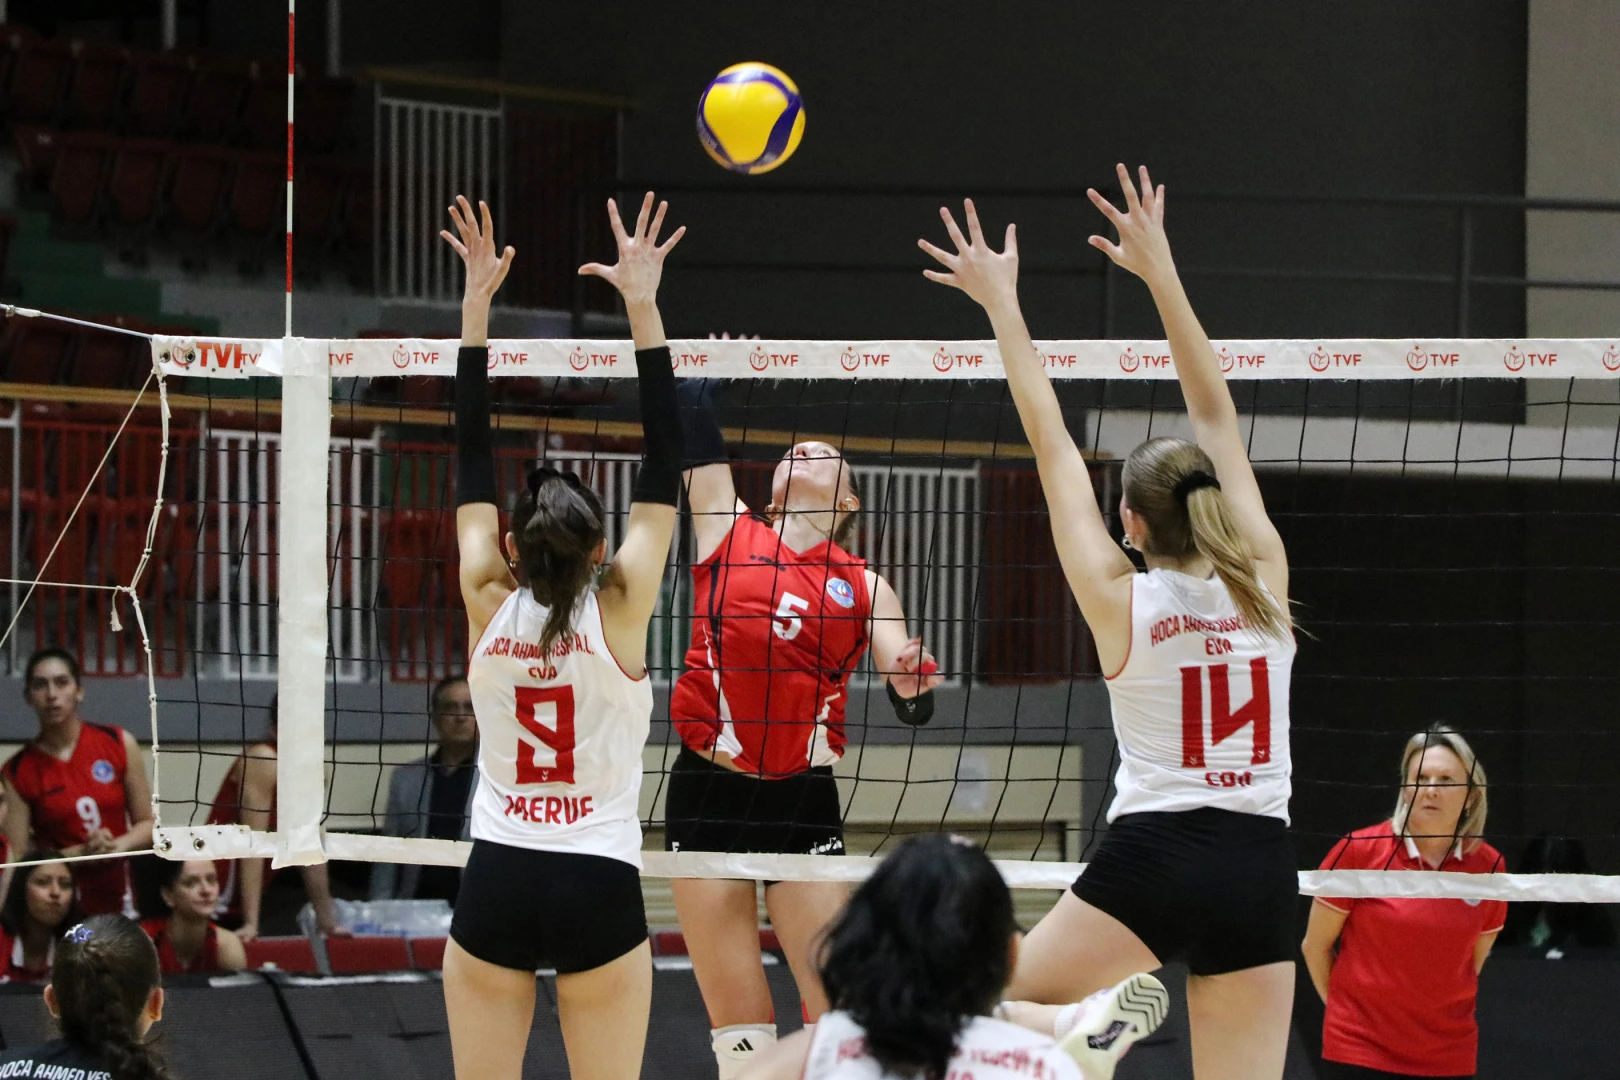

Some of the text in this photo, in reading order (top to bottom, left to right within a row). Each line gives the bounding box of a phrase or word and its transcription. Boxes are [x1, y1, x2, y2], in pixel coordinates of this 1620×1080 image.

[241, 353, 261, 365] TV
[329, 353, 353, 365] TVF
[413, 351, 439, 363] TVF
[501, 353, 528, 365] TVF
[590, 353, 617, 366] TVF
[681, 354, 708, 366] TVF
[771, 354, 798, 366] TVF
[863, 354, 889, 366] TVF
[956, 355, 982, 366] TVF
[1048, 355, 1076, 366] TVF
[1142, 355, 1170, 367] TVF
[1237, 355, 1265, 367] TVF
[1333, 354, 1361, 366] TVF
[1430, 353, 1459, 366] TVF
[1528, 353, 1557, 366] TVF
[773, 592, 809, 640] 5
[1150, 615, 1180, 647] HOCA
[1205, 638, 1234, 656] EVA
[1180, 656, 1271, 768] 14
[76, 796, 101, 832] 9
